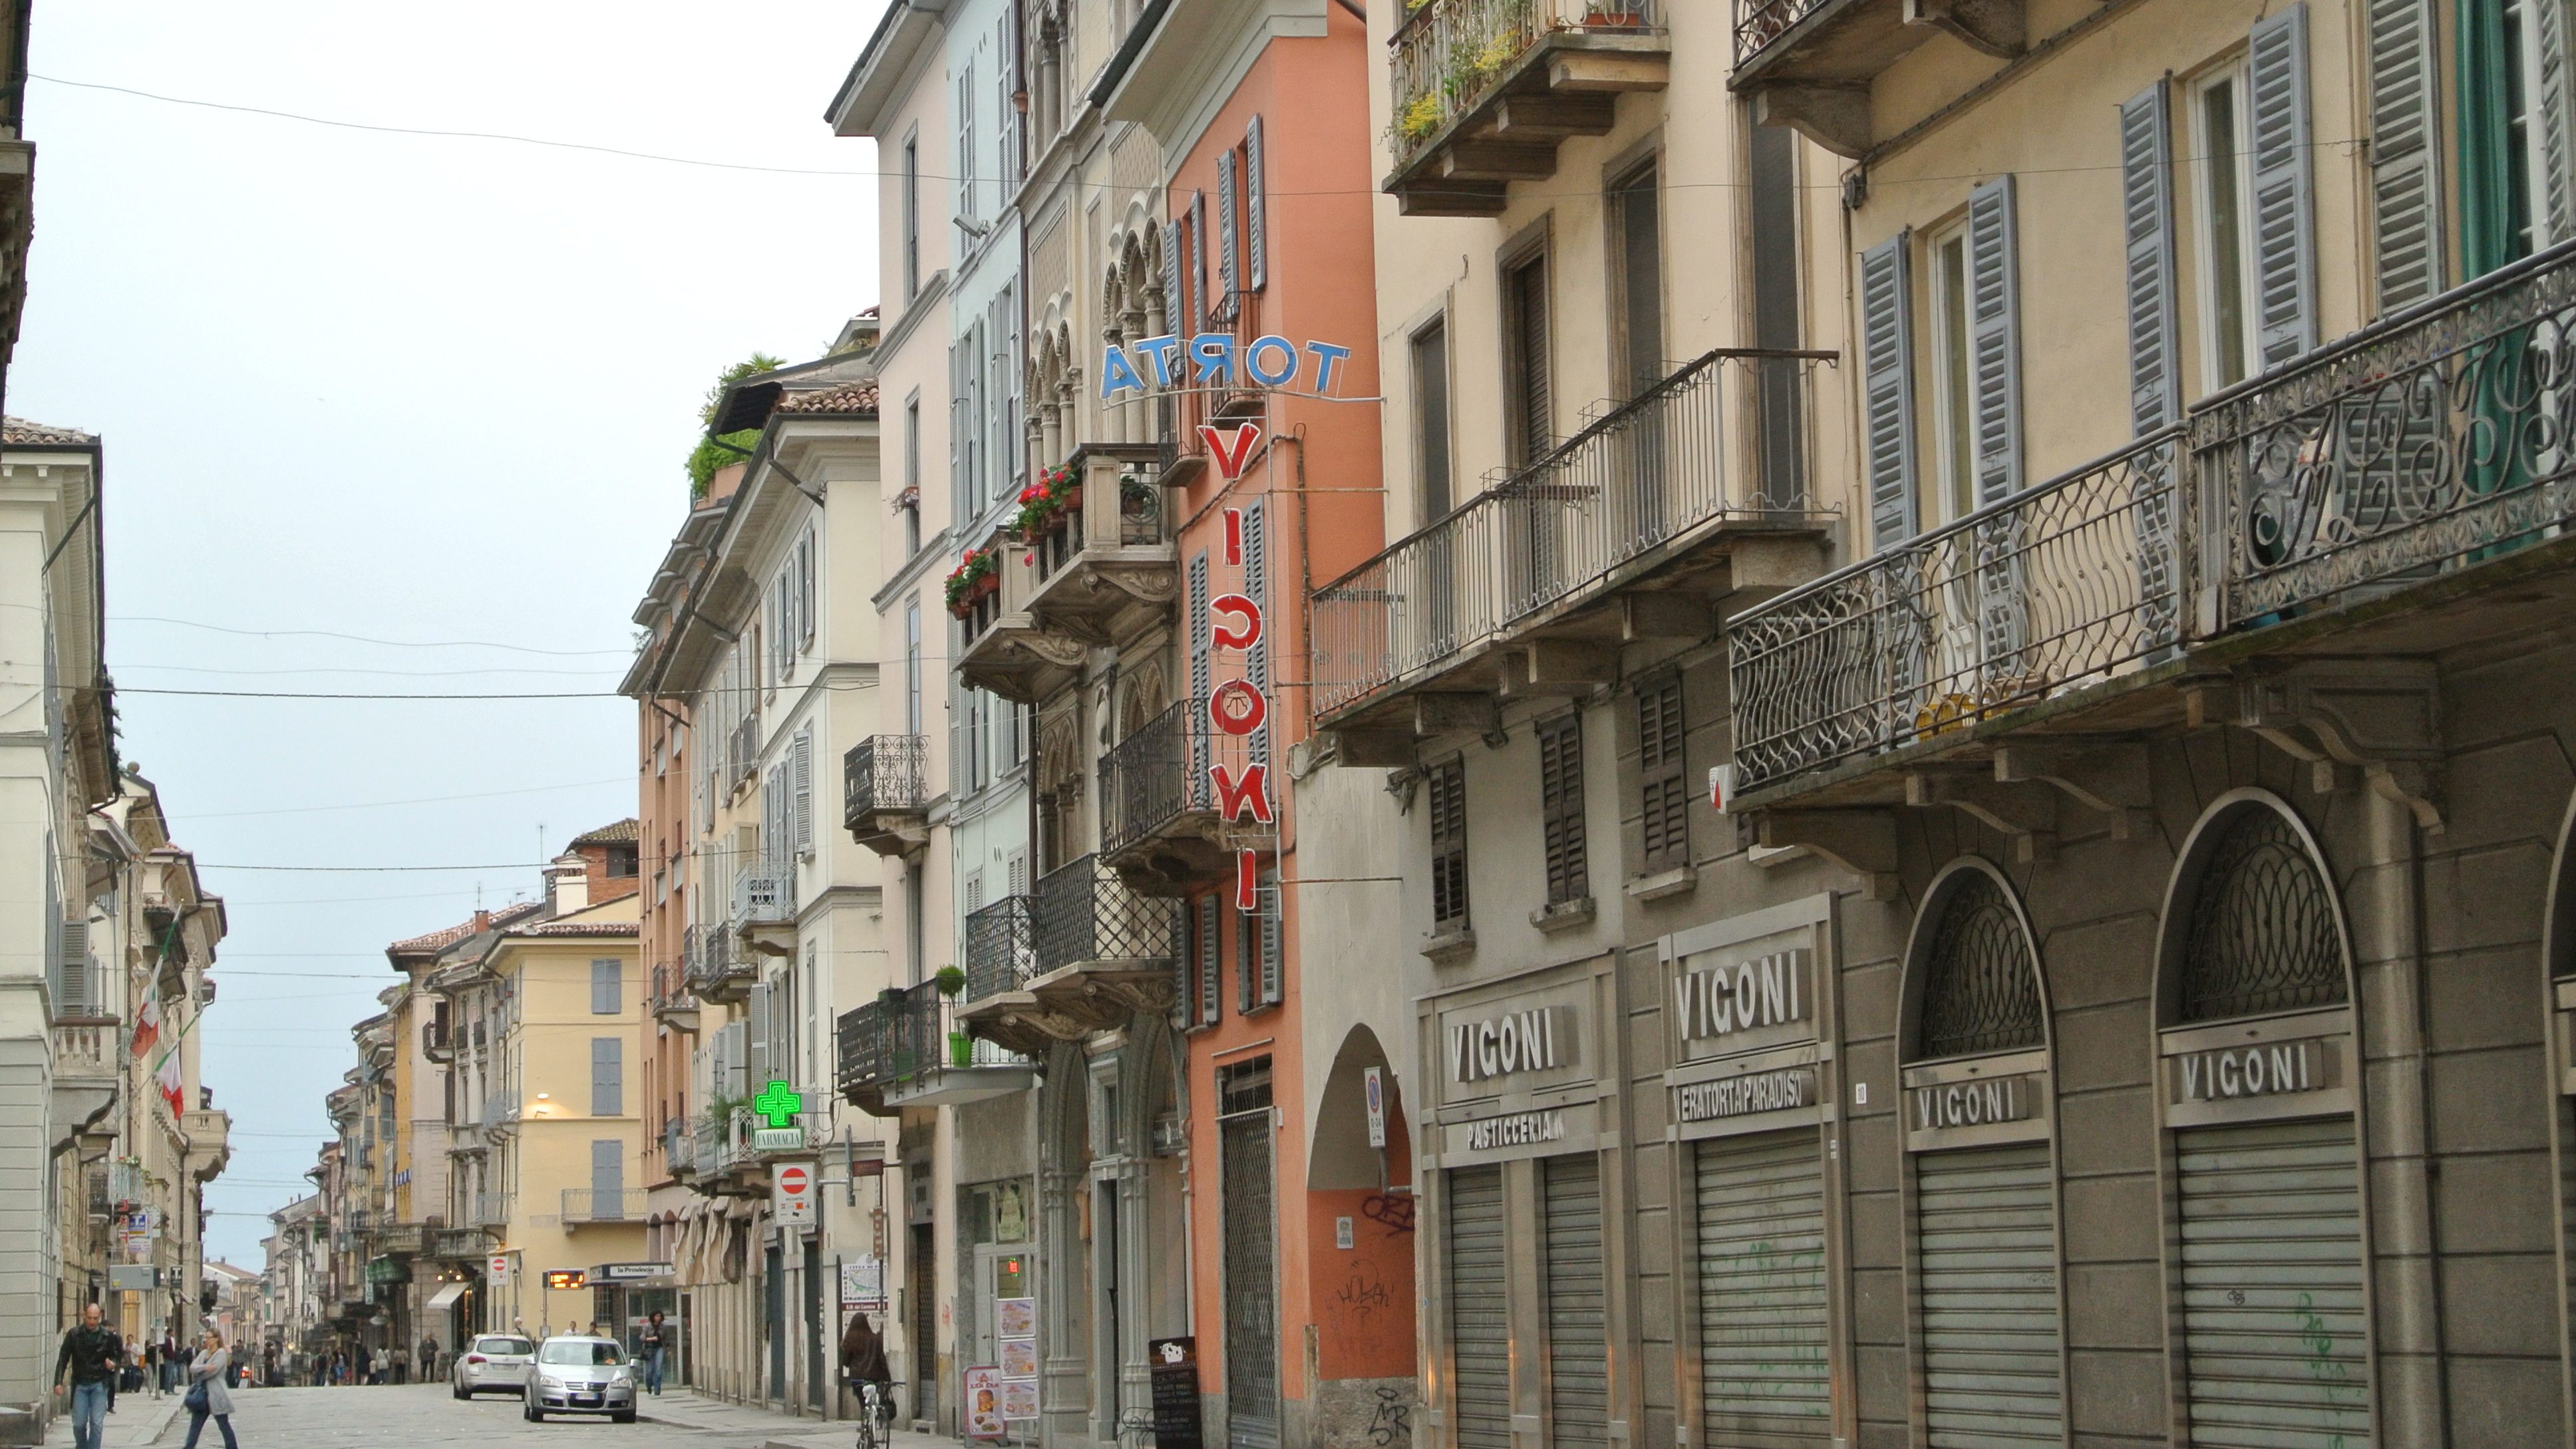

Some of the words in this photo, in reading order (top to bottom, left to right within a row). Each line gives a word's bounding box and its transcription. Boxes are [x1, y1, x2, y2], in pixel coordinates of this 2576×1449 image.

[1675, 950, 1798, 1041] VIGONI
[1450, 1008, 1554, 1082] VIGONI
[1704, 1078, 1740, 1118] TORTA
[1744, 1072, 1802, 1113] PARADISO
[2181, 1044, 2308, 1098] VIGONI
[1919, 1080, 2014, 1128] VIGONI
[756, 1132, 800, 1146] FARMACIA
[1467, 1111, 1555, 1150] PASTICCERIA
